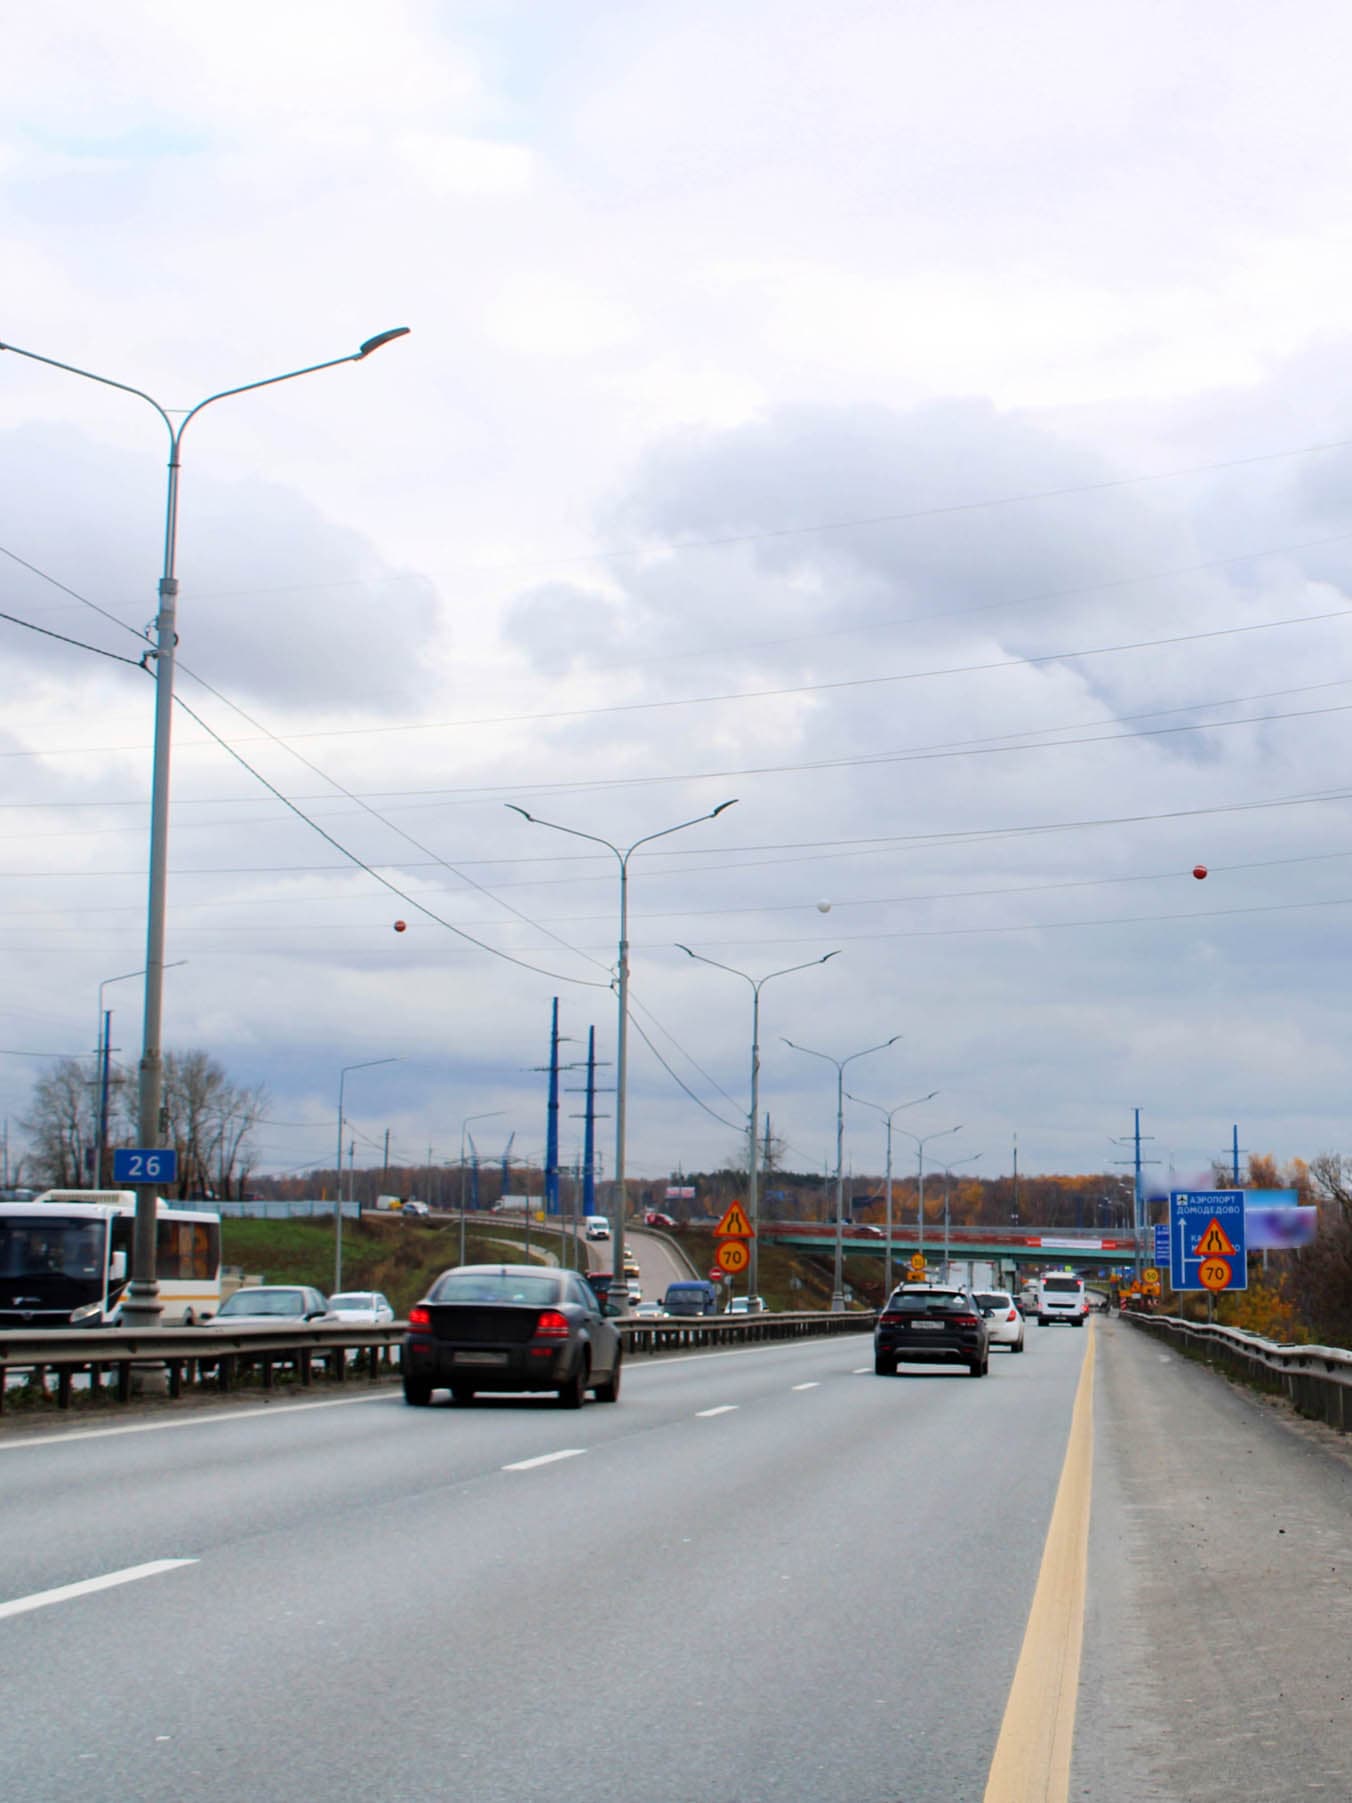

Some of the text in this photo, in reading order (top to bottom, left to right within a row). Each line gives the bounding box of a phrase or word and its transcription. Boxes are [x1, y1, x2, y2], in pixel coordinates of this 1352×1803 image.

[128, 1155, 160, 1177] 26
[1190, 1195, 1236, 1205] АЭРОПОРТ
[1176, 1206, 1241, 1215] ДОМОДЕДОВО
[723, 1250, 742, 1264] 70
[1206, 1267, 1225, 1281] 70
